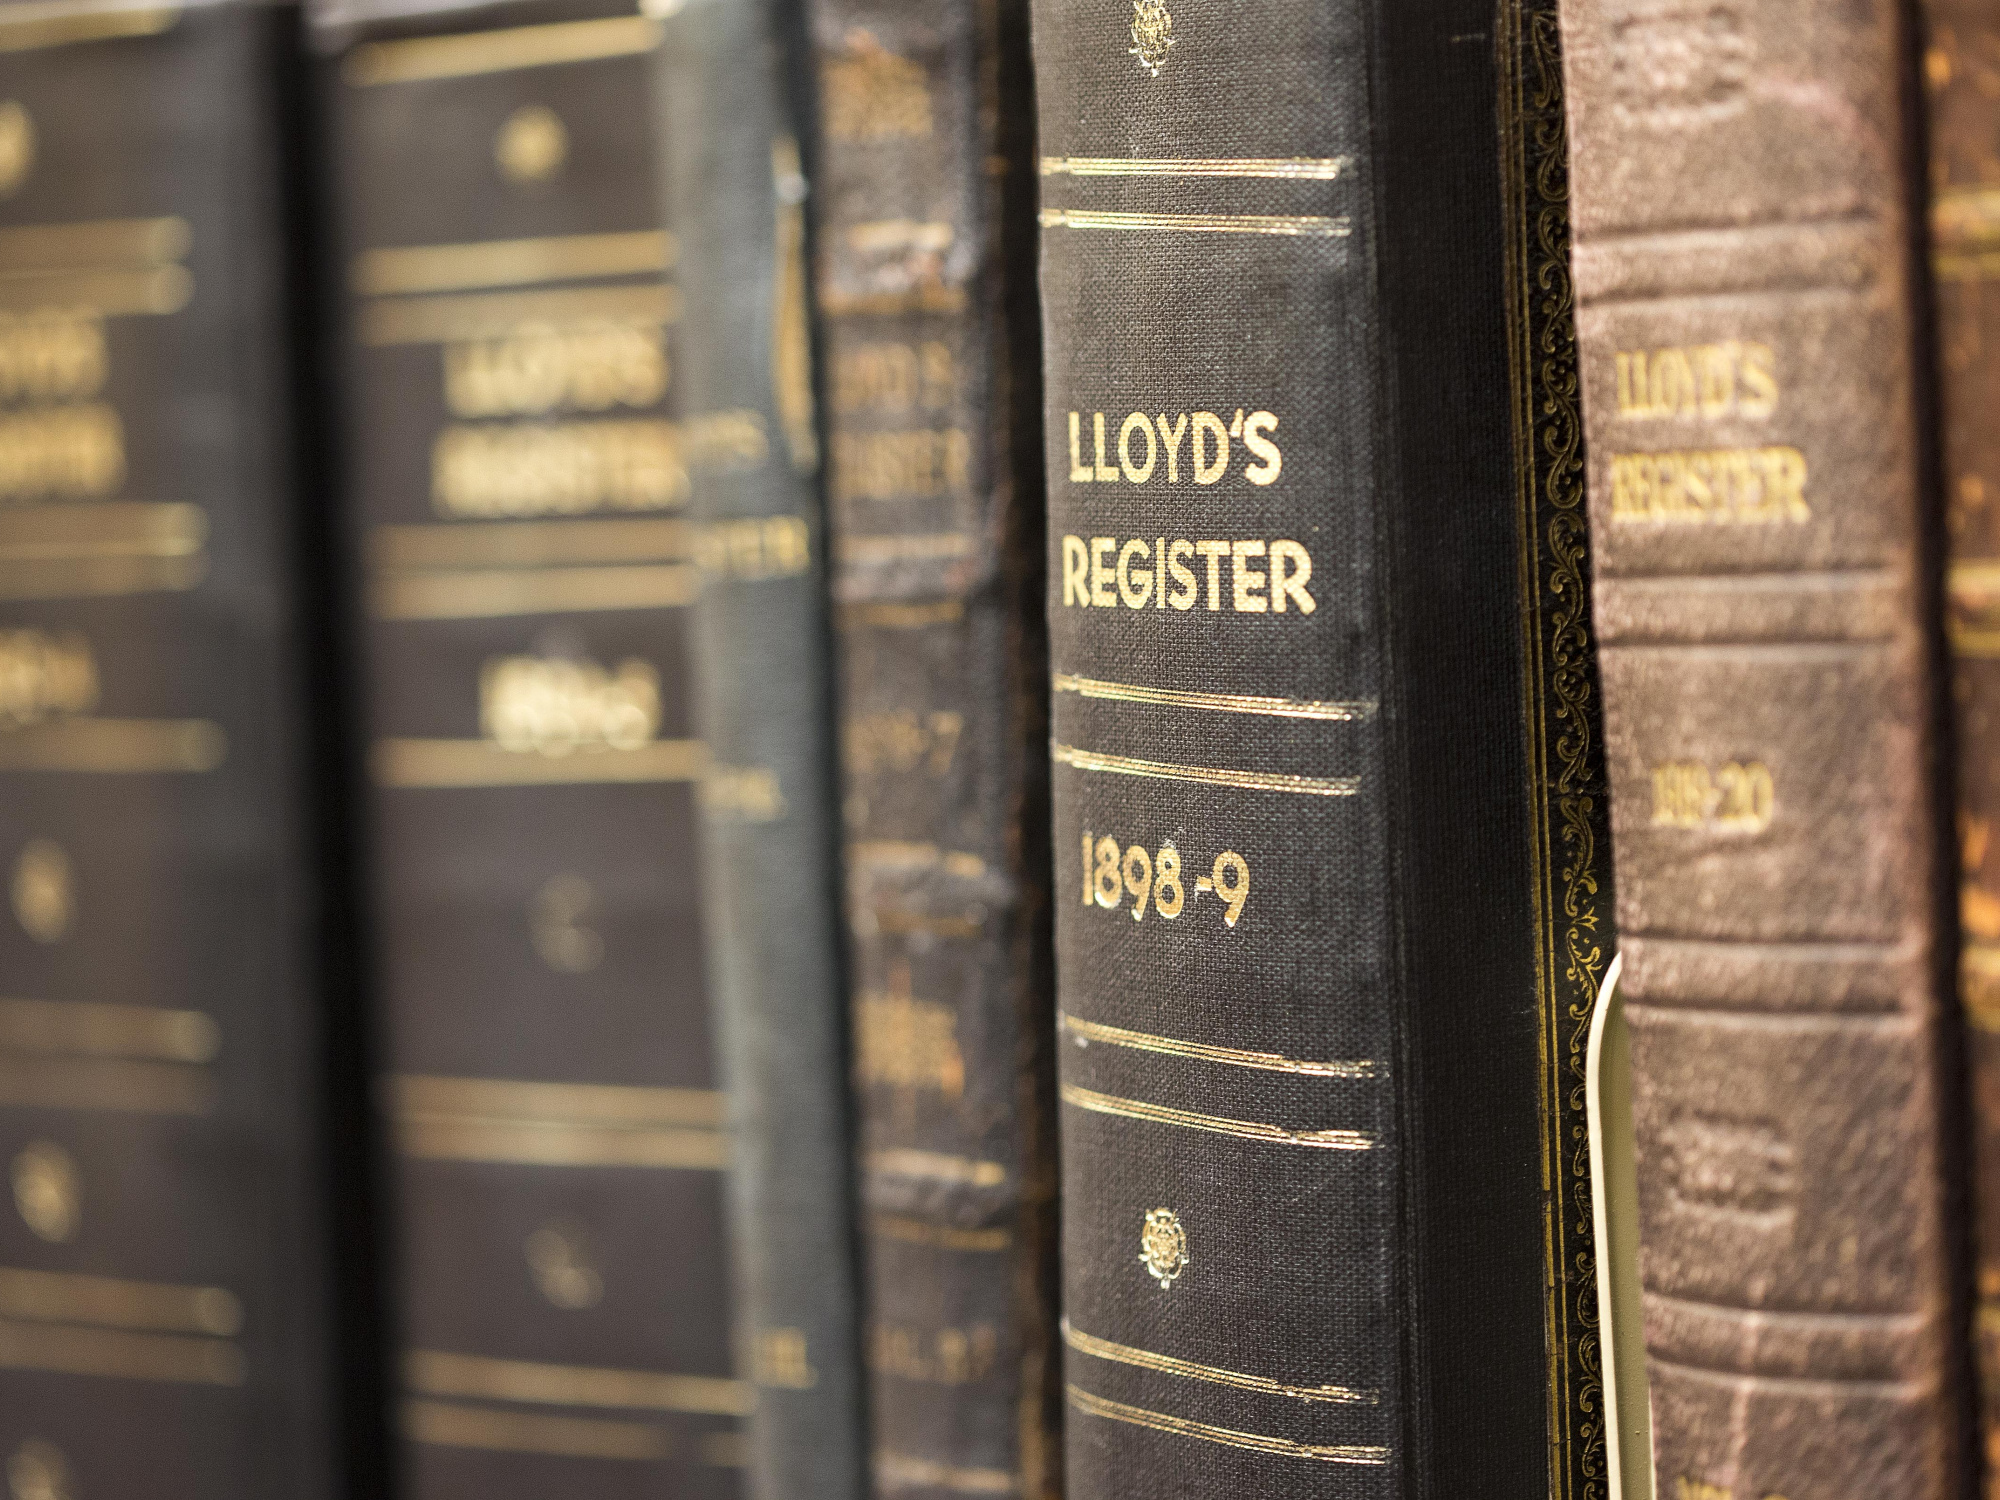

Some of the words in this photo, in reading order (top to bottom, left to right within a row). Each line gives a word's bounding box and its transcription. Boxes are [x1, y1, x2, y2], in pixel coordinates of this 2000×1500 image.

[1068, 408, 1282, 486] LLOYD'S
[1062, 534, 1317, 614] REGISTER
[1081, 831, 1250, 927] 1898-9
